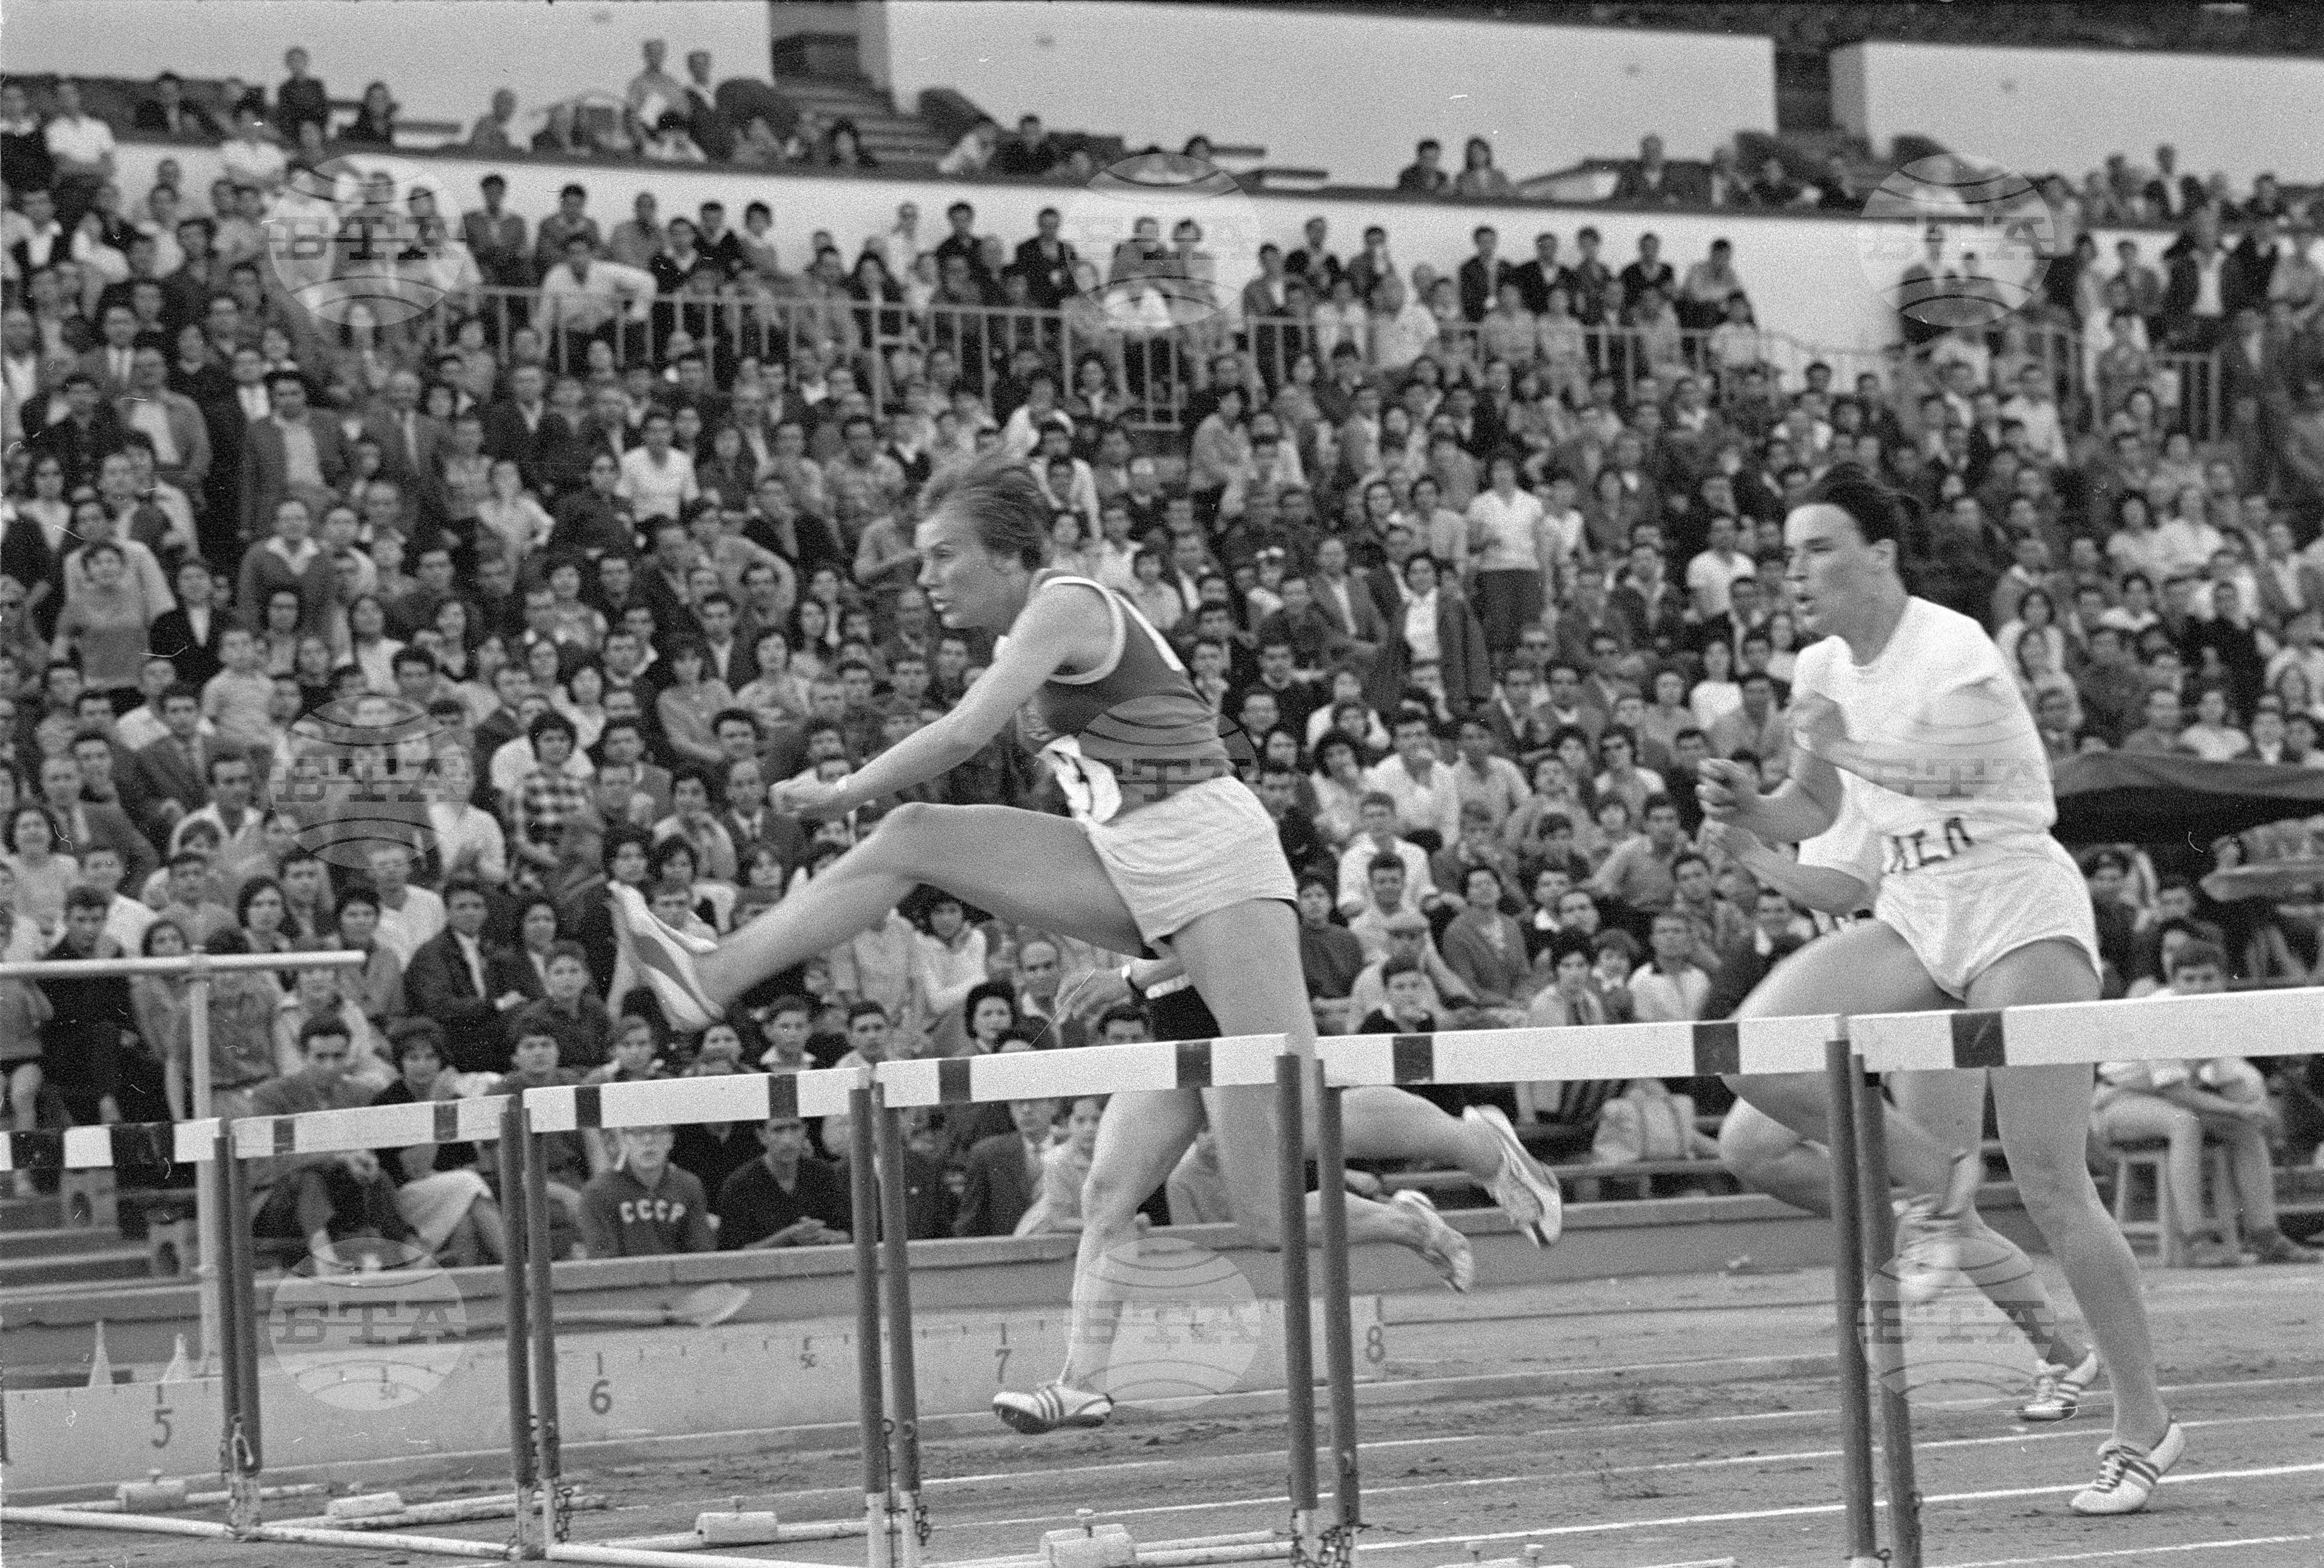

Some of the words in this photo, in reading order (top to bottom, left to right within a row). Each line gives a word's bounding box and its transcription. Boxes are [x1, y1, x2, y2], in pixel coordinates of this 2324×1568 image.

[619, 1199, 686, 1223] СССР
[1366, 1325, 1385, 1363] 8
[995, 1348, 1012, 1384] 7
[589, 1379, 611, 1415] 6
[152, 1408, 173, 1448] 5
